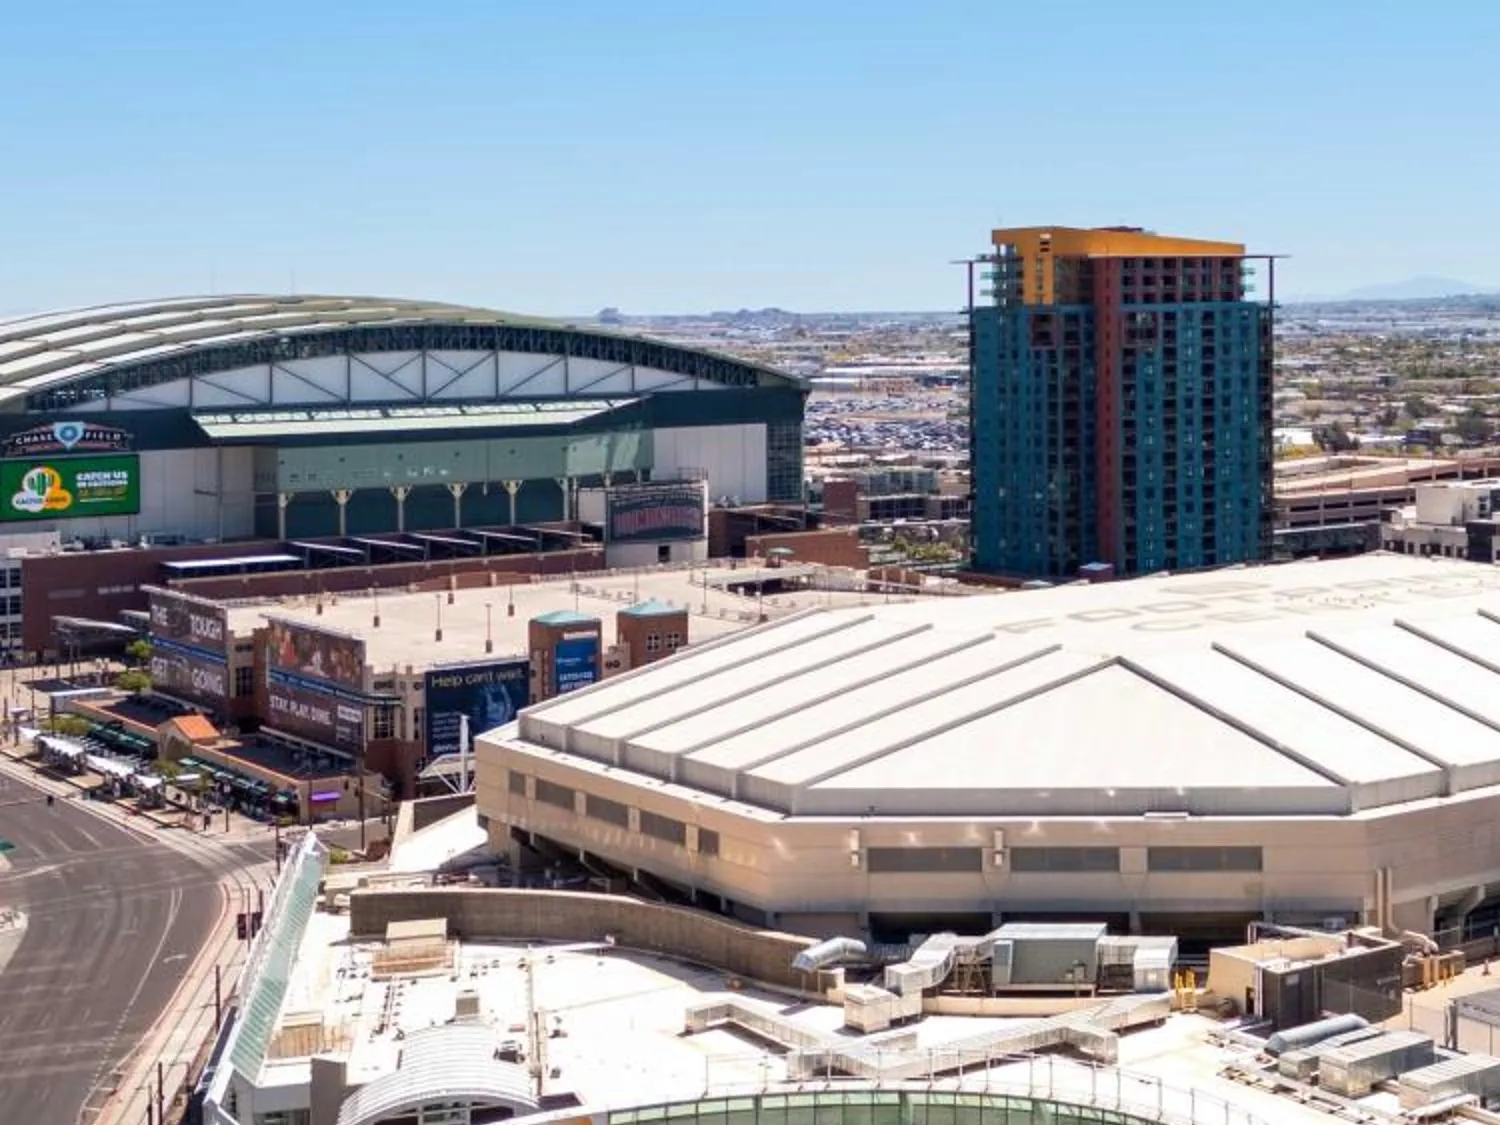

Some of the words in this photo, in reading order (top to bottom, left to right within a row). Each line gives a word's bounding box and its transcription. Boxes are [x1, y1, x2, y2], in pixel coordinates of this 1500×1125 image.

[15, 433, 53, 445] CHASE
[85, 431, 122, 441] FIELD
[113, 468, 128, 479] US
[190, 613, 223, 641] TOUGH
[431, 675, 463, 689] Help
